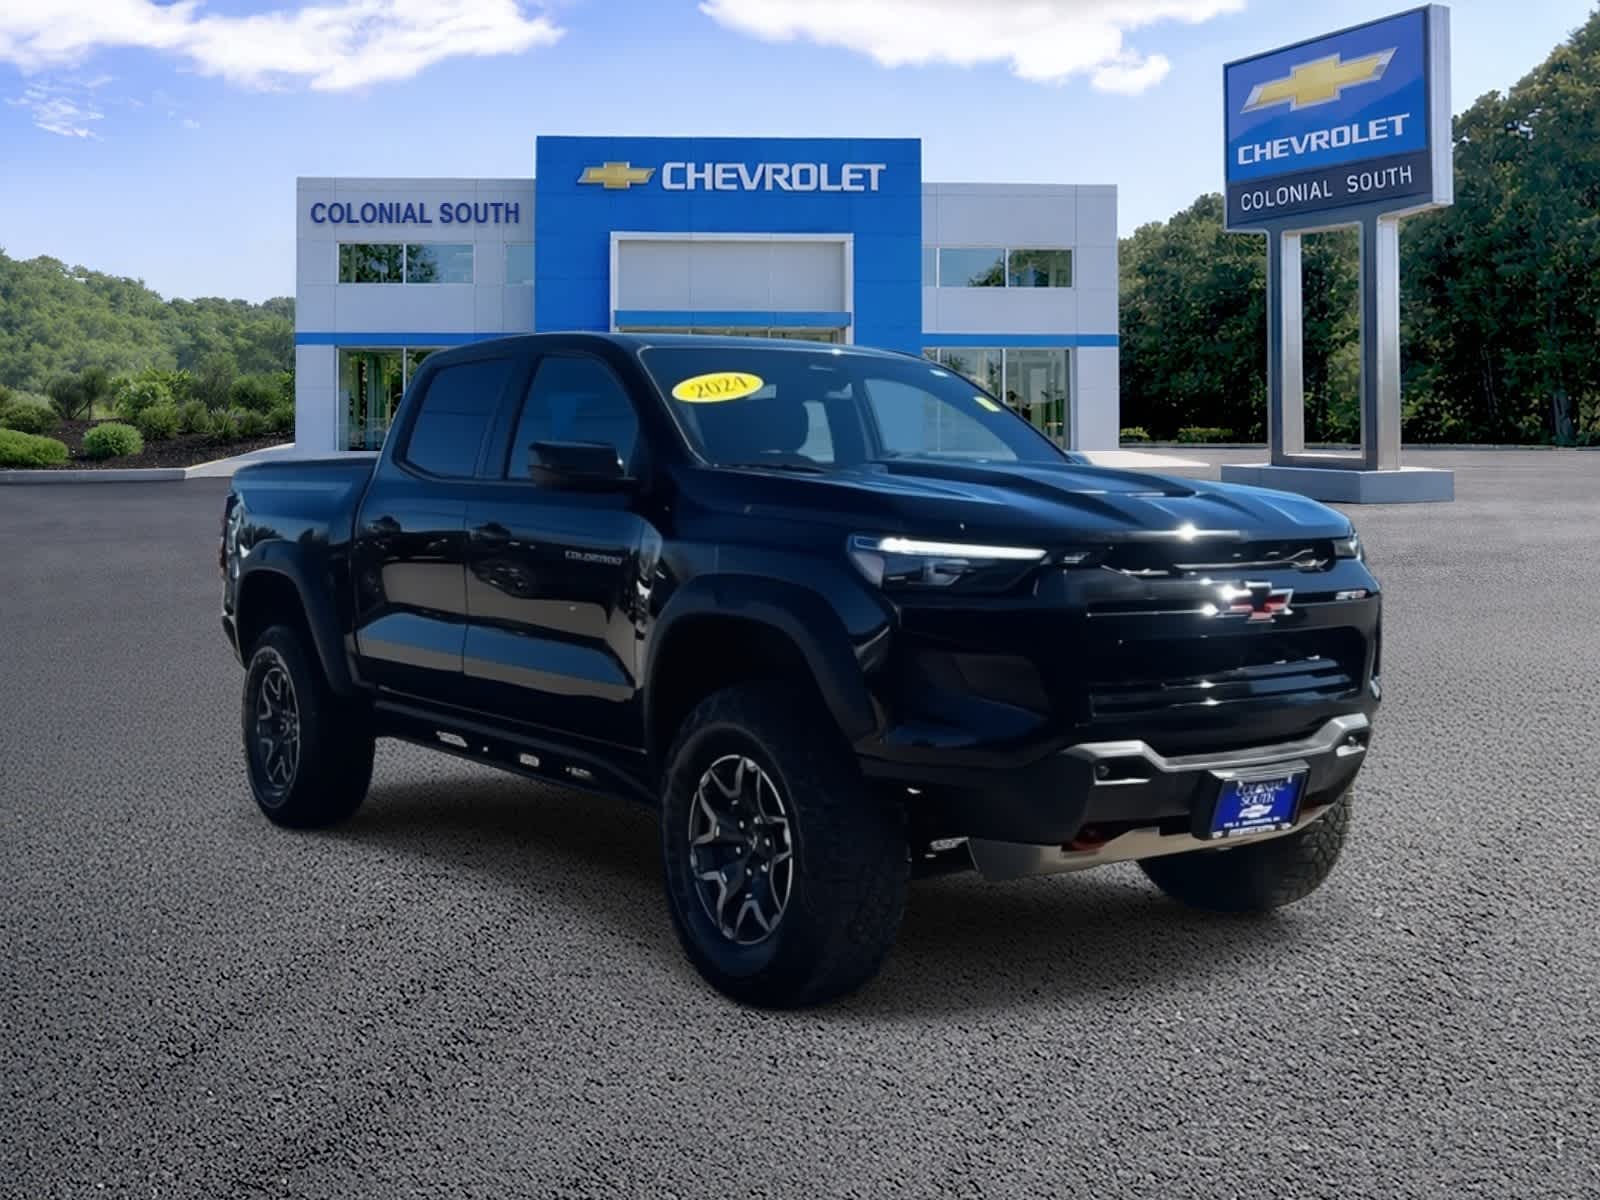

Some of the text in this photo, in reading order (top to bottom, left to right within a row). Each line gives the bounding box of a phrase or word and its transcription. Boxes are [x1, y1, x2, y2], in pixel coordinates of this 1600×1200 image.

[1238, 113, 1410, 165] CHEVROLET
[662, 162, 887, 192] CHEVROLET
[1241, 165, 1412, 211] COLONIAL SOUTH
[311, 202, 519, 224] COLONIAL SOUTH
